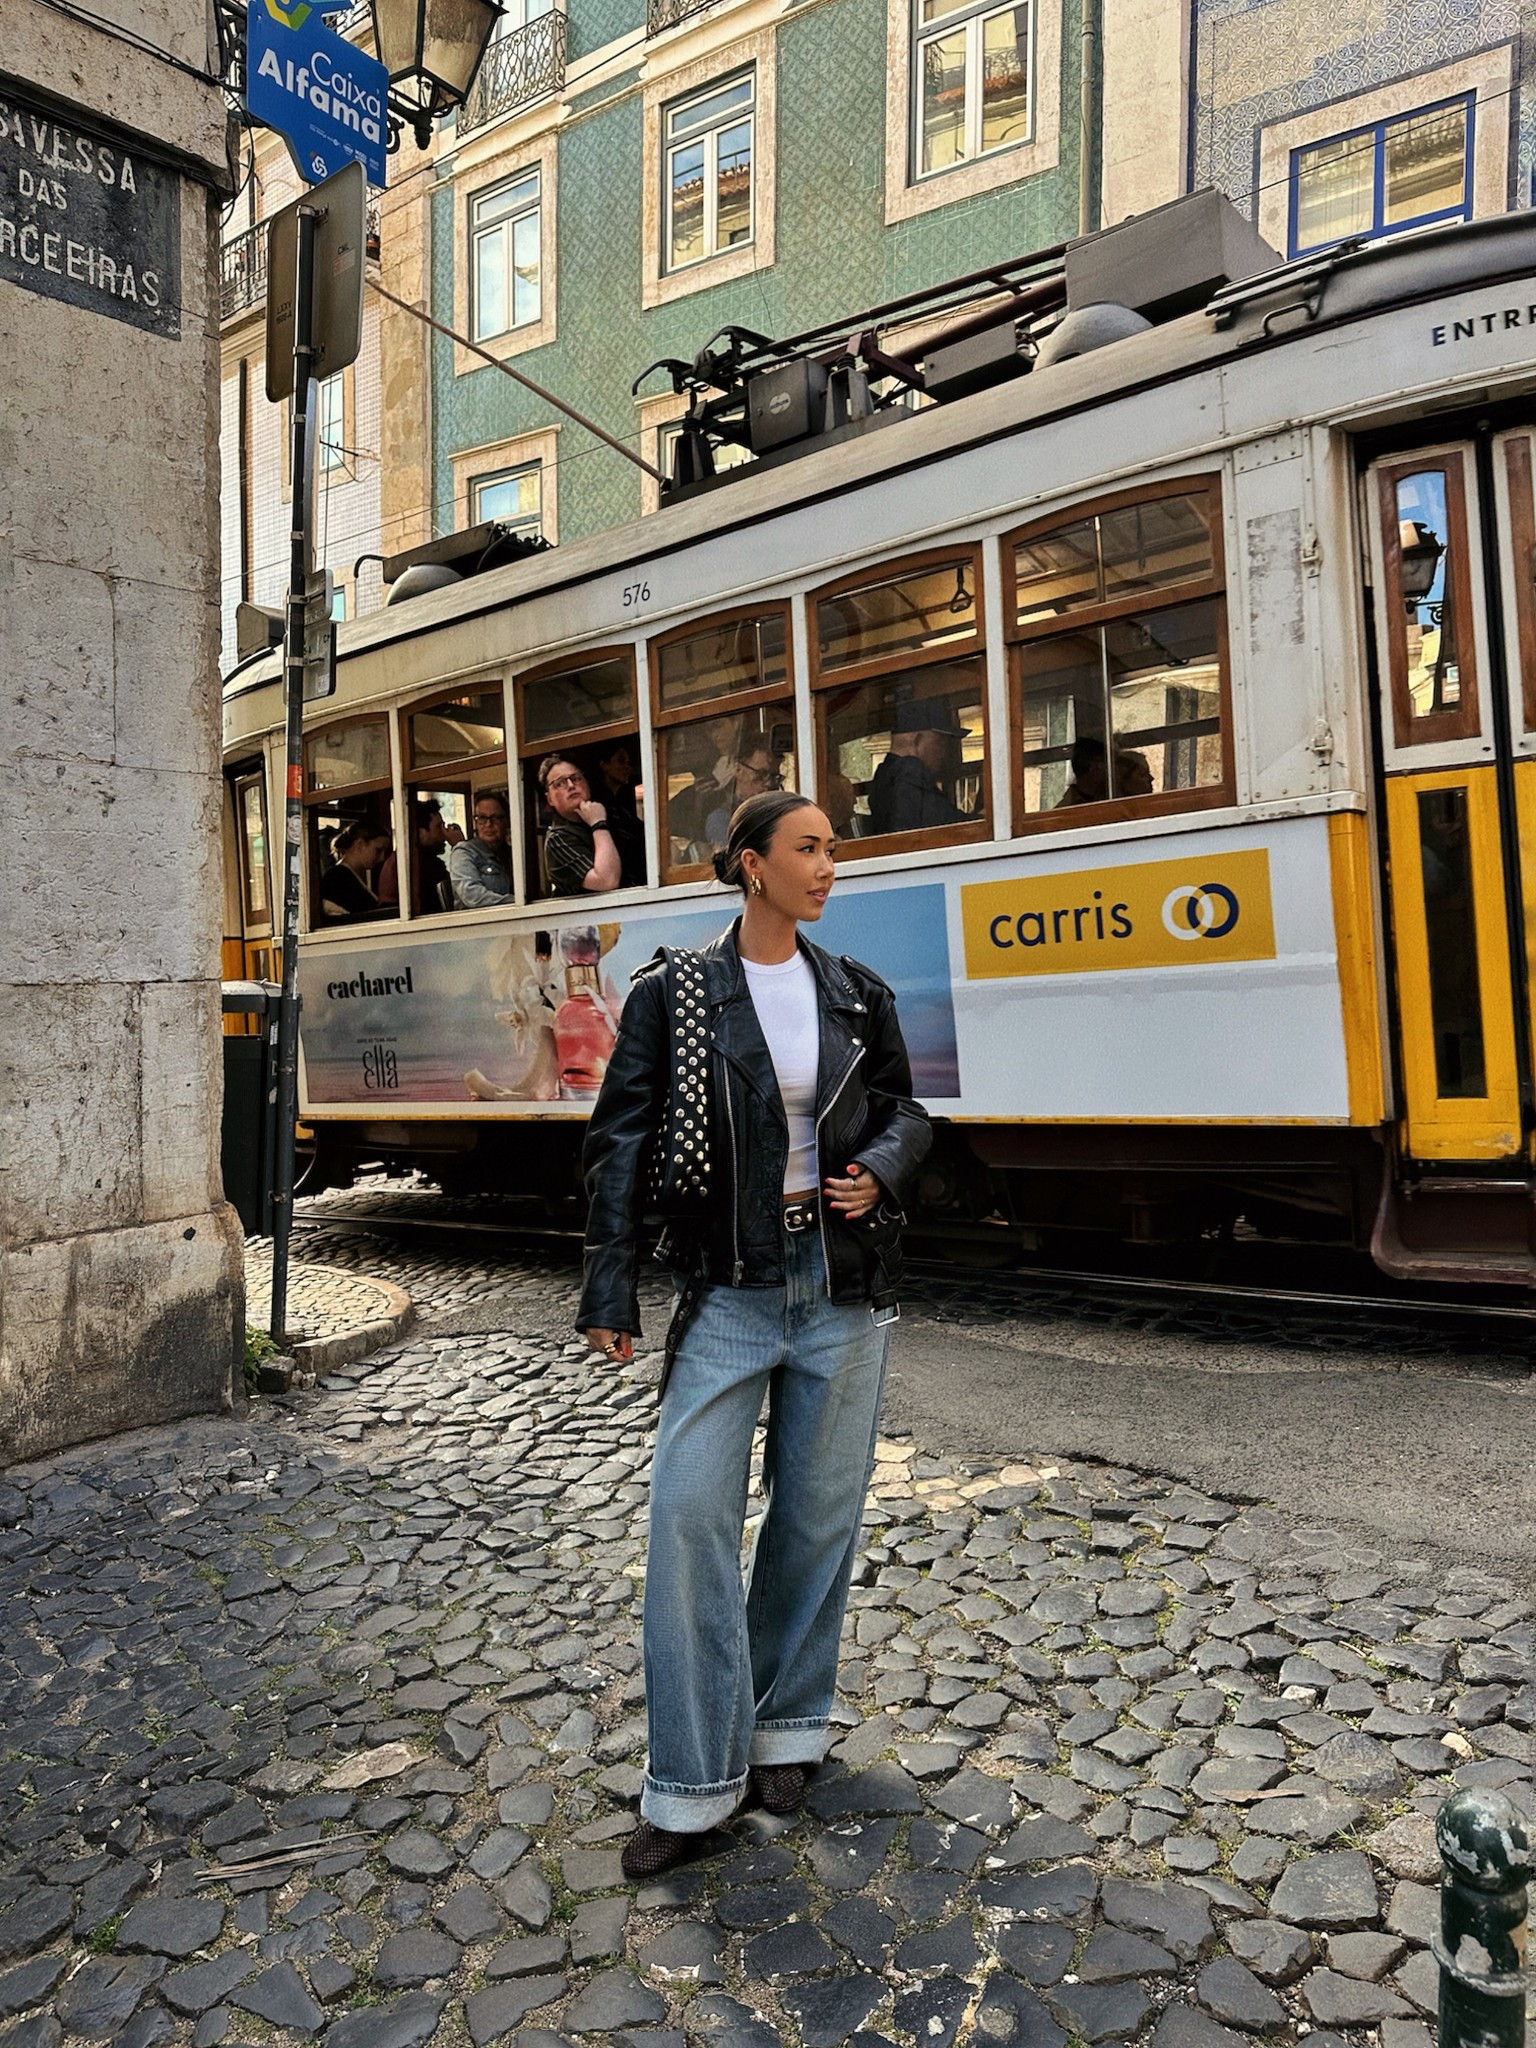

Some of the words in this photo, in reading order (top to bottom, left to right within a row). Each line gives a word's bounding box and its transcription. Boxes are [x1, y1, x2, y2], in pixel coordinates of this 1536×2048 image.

[257, 48, 381, 145] Alfama
[311, 51, 381, 119] Caixa
[19, 168, 67, 210] DAS
[623, 581, 650, 606] 576
[990, 890, 1133, 949] carris
[327, 966, 414, 1000] cacharel
[362, 1044, 398, 1071] ella
